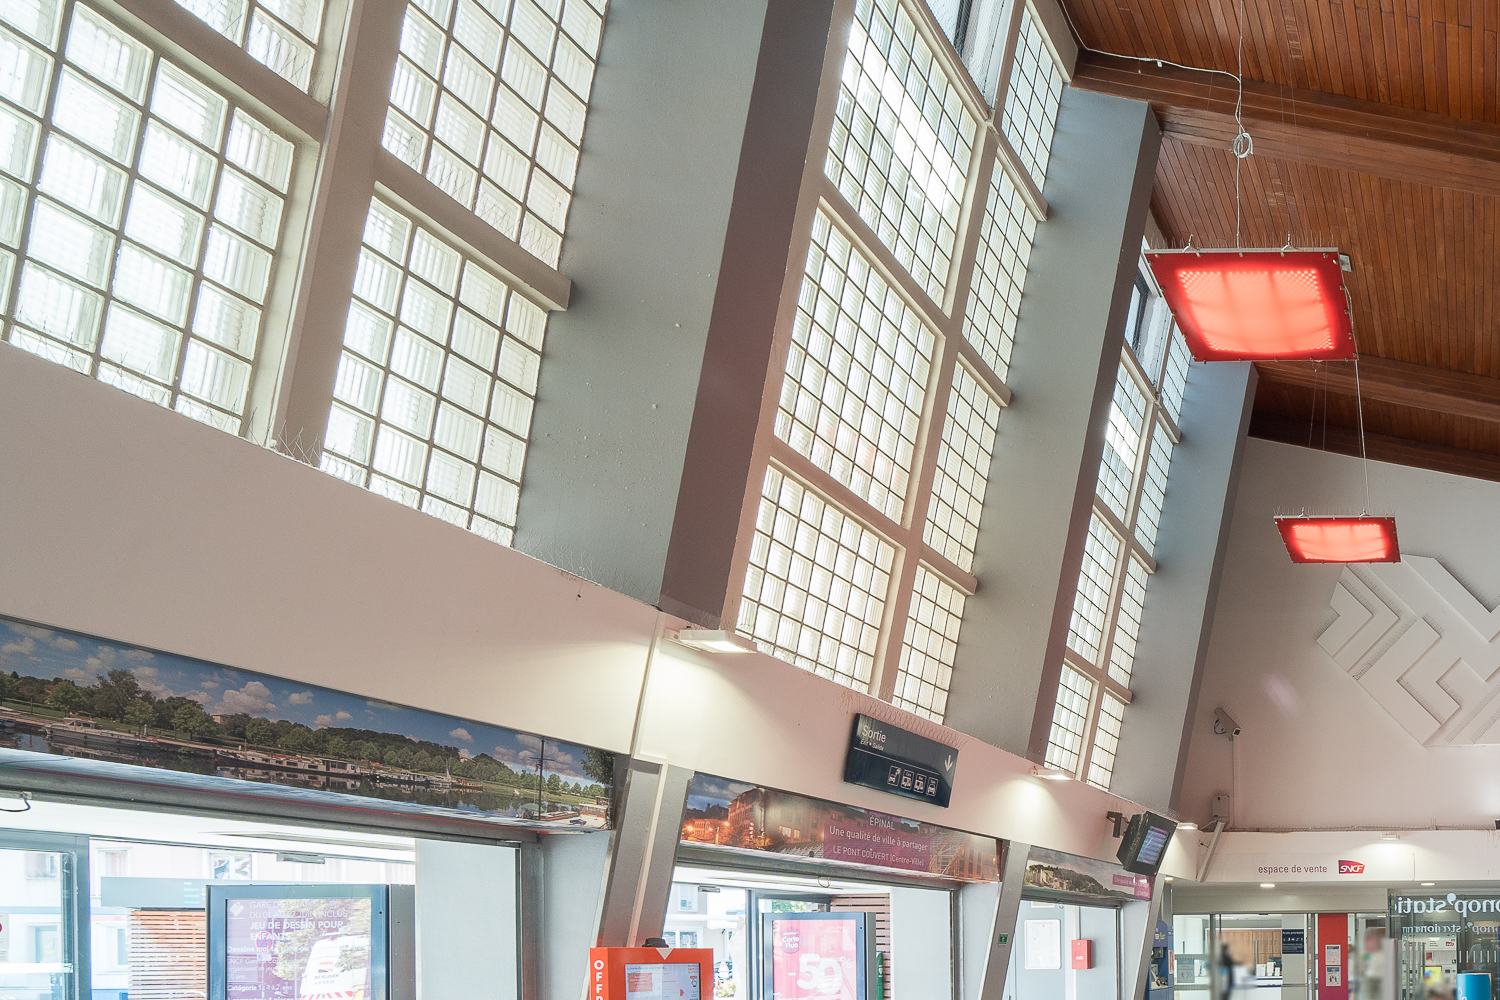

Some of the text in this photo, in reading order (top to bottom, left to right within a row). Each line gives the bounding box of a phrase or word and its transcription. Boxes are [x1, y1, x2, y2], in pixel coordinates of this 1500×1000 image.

[862, 725, 887, 743] Sortie
[869, 815, 895, 830] ÉPINAL
[829, 825, 928, 852] Une qualité de ville à partager
[832, 845, 841, 854] LE
[842, 846, 860, 857] PONT
[889, 853, 925, 867] (Centre-Ville)
[1258, 865, 1328, 875] espace de vente
[1340, 864, 1364, 873] SNCF
[250, 901, 274, 909] GARE
[250, 910, 262, 919] DU
[262, 910, 273, 918] 01
[318, 909, 348, 918] INCLUS
[250, 920, 344, 930] JEU DE DESSIN POUR
